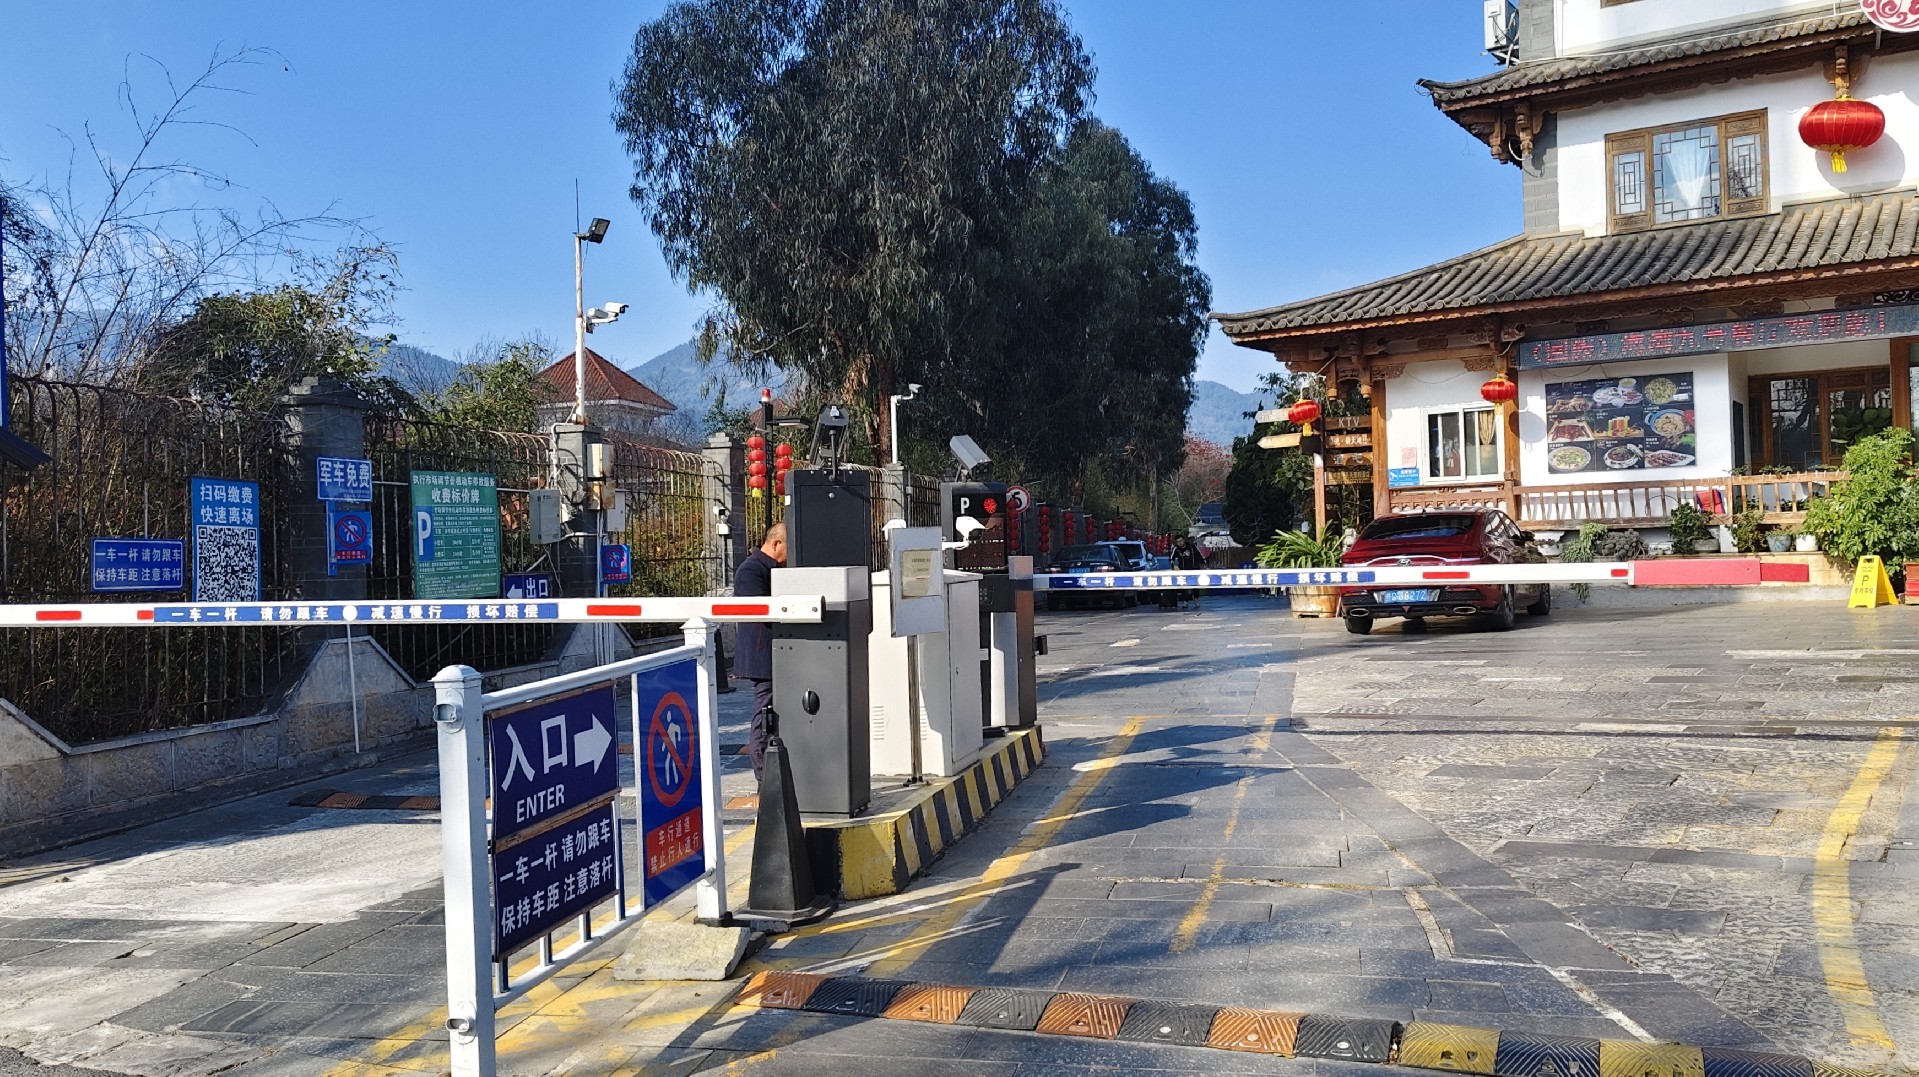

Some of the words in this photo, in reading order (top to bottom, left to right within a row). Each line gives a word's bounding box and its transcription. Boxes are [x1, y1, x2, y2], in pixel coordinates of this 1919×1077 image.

[1338, 417, 1360, 427] KTV
[320, 461, 370, 488] 军车免费
[200, 483, 253, 504] 扫码缴费
[431, 487, 481, 504] 收费标价牌
[200, 506, 254, 525] 快速离场
[960, 497, 970, 514] P
[417, 511, 432, 556] P
[95, 548, 138, 562] 一车一杆
[141, 547, 182, 562] 请勿跟车
[95, 567, 138, 582] 保持车距
[141, 567, 182, 582] 注意落杆
[1063, 576, 1115, 587] 一车一杆
[1133, 575, 1187, 587] 请勿跟车
[1862, 575, 1869, 585] P
[526, 577, 549, 599] 出口
[172, 607, 237, 621] 一车一杆
[261, 606, 329, 620] 请勿跟车
[371, 605, 442, 619] 减速慢行
[467, 604, 539, 619] 损坏赔偿
[501, 714, 568, 792] 入口
[516, 784, 565, 823] ENTER
[658, 815, 690, 847] 车行通道
[499, 841, 558, 885] 一车一杆
[561, 818, 611, 862] 请勿跟车
[650, 832, 699, 874] 禁止行人通行
[501, 882, 560, 937] 保持车距
[563, 854, 613, 901] 注意落杆
